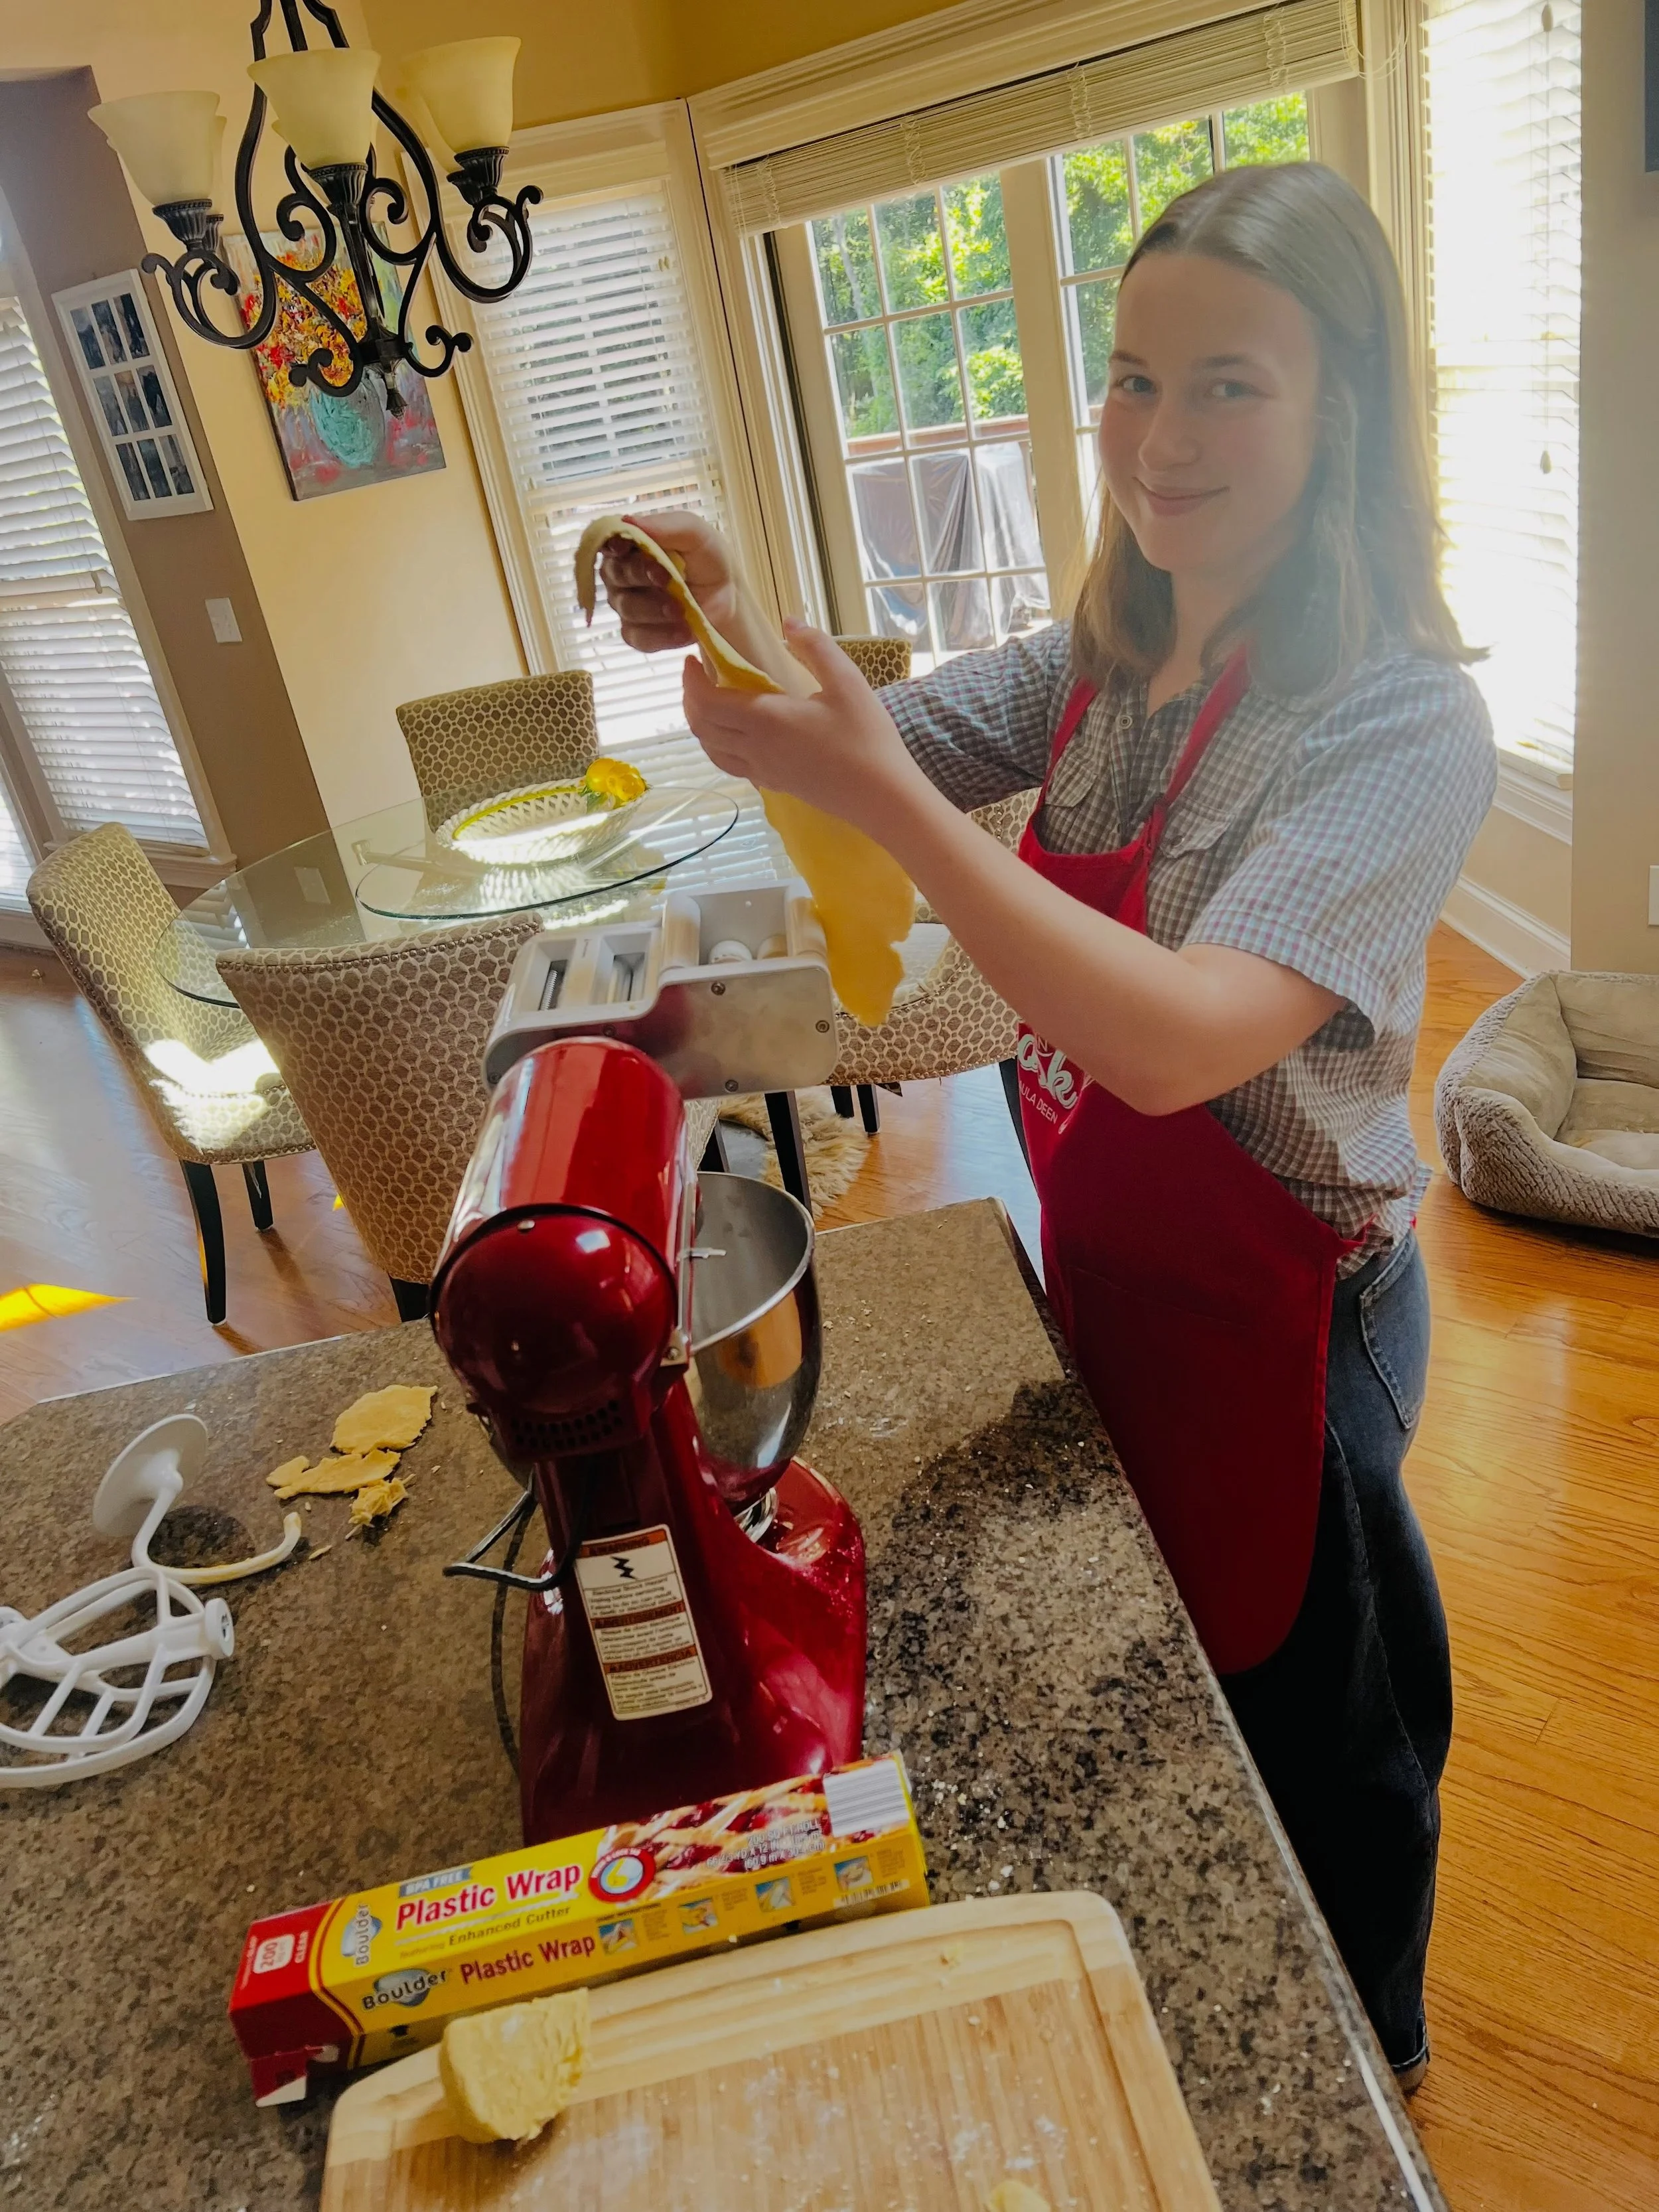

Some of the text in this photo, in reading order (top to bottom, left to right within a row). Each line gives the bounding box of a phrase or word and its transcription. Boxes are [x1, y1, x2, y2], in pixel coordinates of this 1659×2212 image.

[1036, 1098, 1058, 1124] DEEN
[396, 1864, 581, 1930] Plastic Wrap
[432, 1870, 463, 1889] FREE
[355, 1903, 370, 1966] Boulder
[449, 1917, 521, 1945] Enhanced
[526, 1905, 570, 1925] Cutter
[259, 1942, 277, 1969] 200
[361, 1935, 595, 2011] Boulder Plastic Wrap
